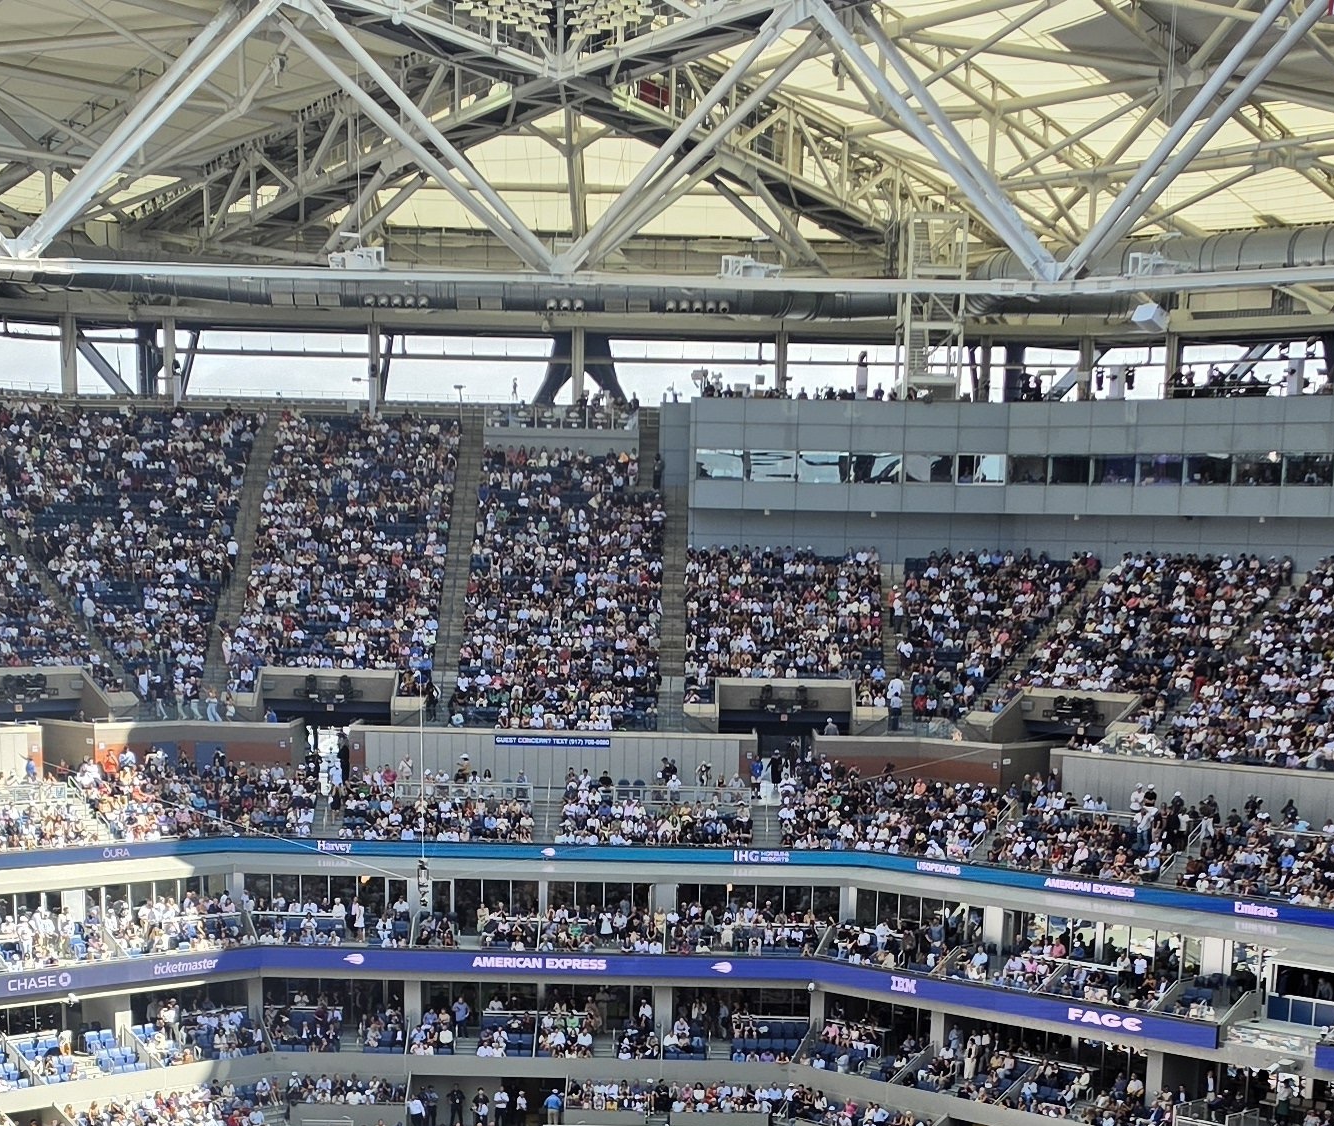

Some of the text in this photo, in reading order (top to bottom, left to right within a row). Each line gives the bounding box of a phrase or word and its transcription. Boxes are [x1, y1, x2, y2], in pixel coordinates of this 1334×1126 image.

[496, 736, 517, 744] GUEST
[317, 840, 352, 854] Harvey
[733, 850, 760, 862] IHG
[1044, 877, 1135, 898] AMERICAN EXPRESS
[1234, 901, 1279, 918] Emirates
[153, 958, 219, 976] ticketmaster
[472, 956, 607, 971] AMERICAN EXPRESS
[7, 975, 57, 992] CHASE
[890, 975, 917, 995] IBM
[1068, 1007, 1143, 1032] FAGE
